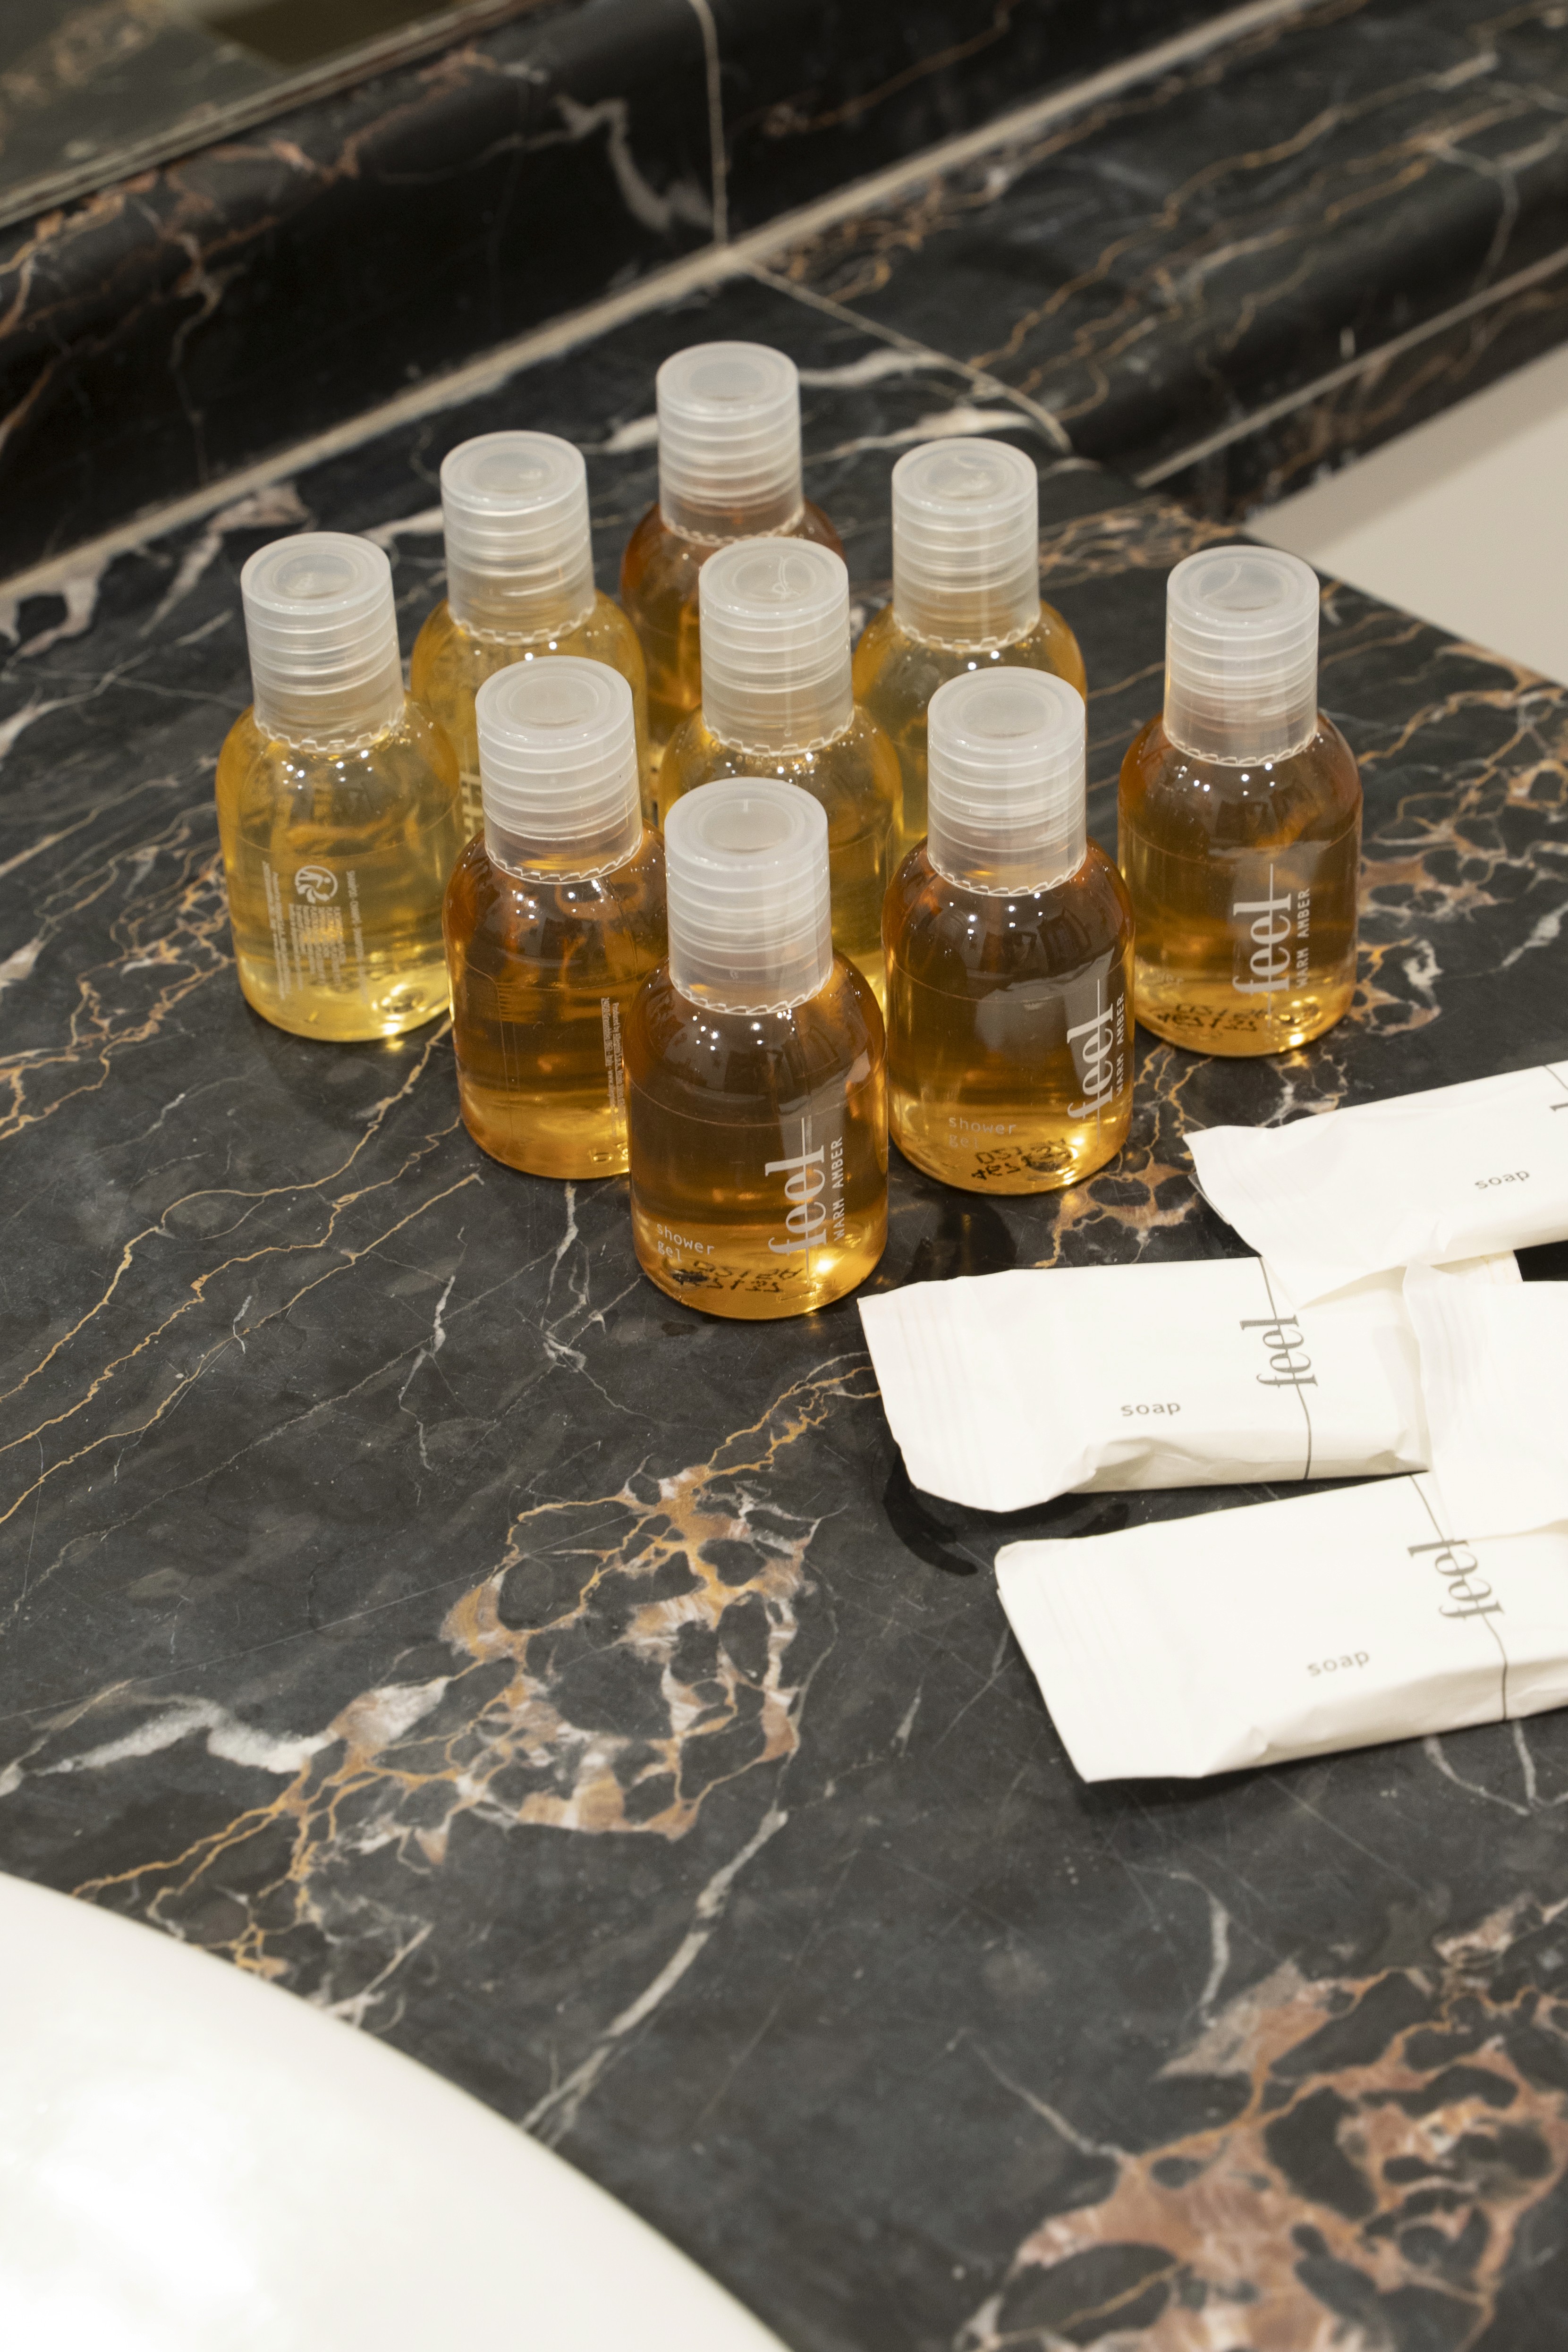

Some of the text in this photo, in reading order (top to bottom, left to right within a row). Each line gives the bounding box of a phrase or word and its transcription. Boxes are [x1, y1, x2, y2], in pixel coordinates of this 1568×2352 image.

[1233, 893, 1291, 995] feel
[1296, 888, 1310, 989] WARM AMBER
[1067, 1004, 1113, 1120] feel
[949, 1117, 1016, 1135] shower
[949, 1134, 979, 1149] gel
[765, 1145, 826, 1256] feel
[831, 1137, 845, 1241] WARM AMBER
[1474, 1168, 1530, 1190] soap
[656, 1223, 714, 1254] shower
[658, 1241, 682, 1261] gel
[1239, 1314, 1318, 1388] feel
[1120, 1399, 1181, 1416] soap
[1407, 1538, 1504, 1621] feel
[1307, 1649, 1370, 1677] soap
